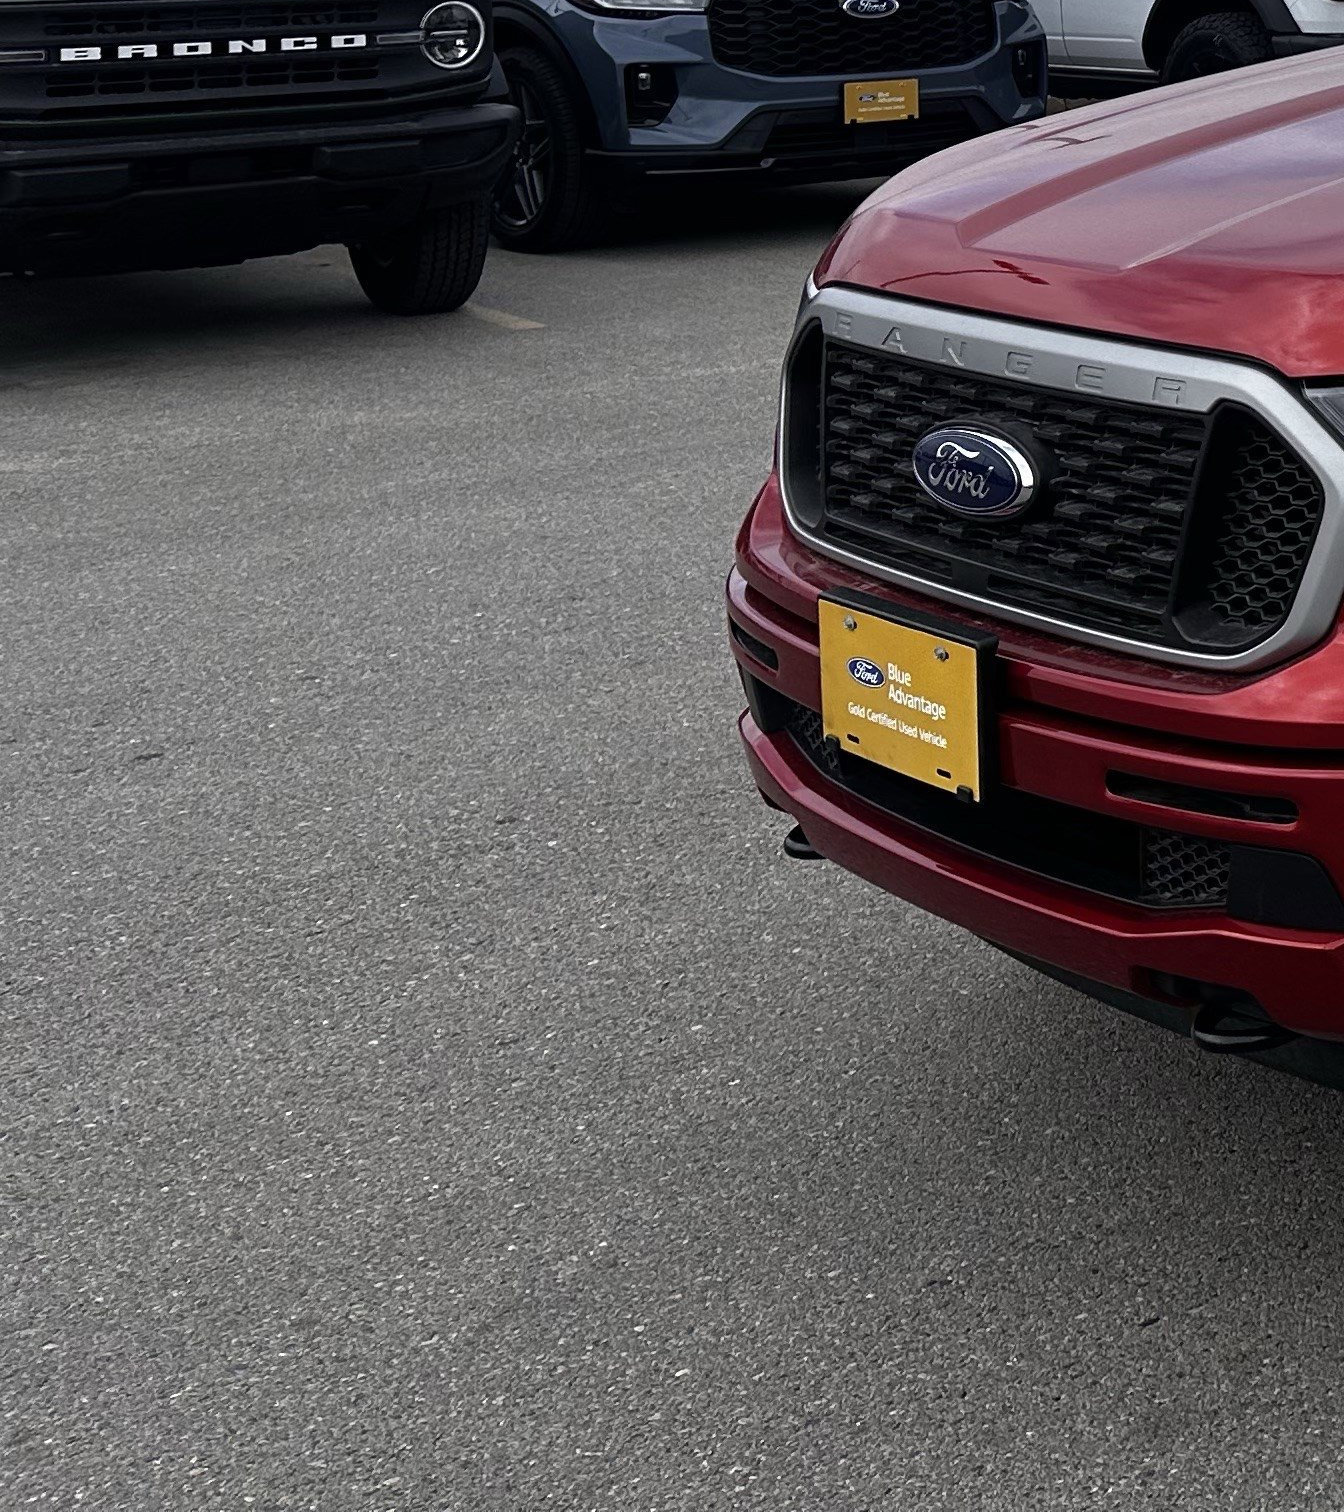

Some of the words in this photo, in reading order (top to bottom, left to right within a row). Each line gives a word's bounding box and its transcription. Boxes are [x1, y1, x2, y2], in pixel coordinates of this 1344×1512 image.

[59, 33, 367, 61] BRONCO
[832, 311, 1187, 406] RANGER
[928, 441, 994, 499] Ford
[854, 661, 879, 684] Ford
[887, 662, 912, 687] Blue
[888, 684, 947, 721] Advantage
[847, 701, 866, 719] Gold
[866, 708, 897, 731] Certified
[898, 720, 918, 738] Used
[919, 728, 948, 749] Vehicle
